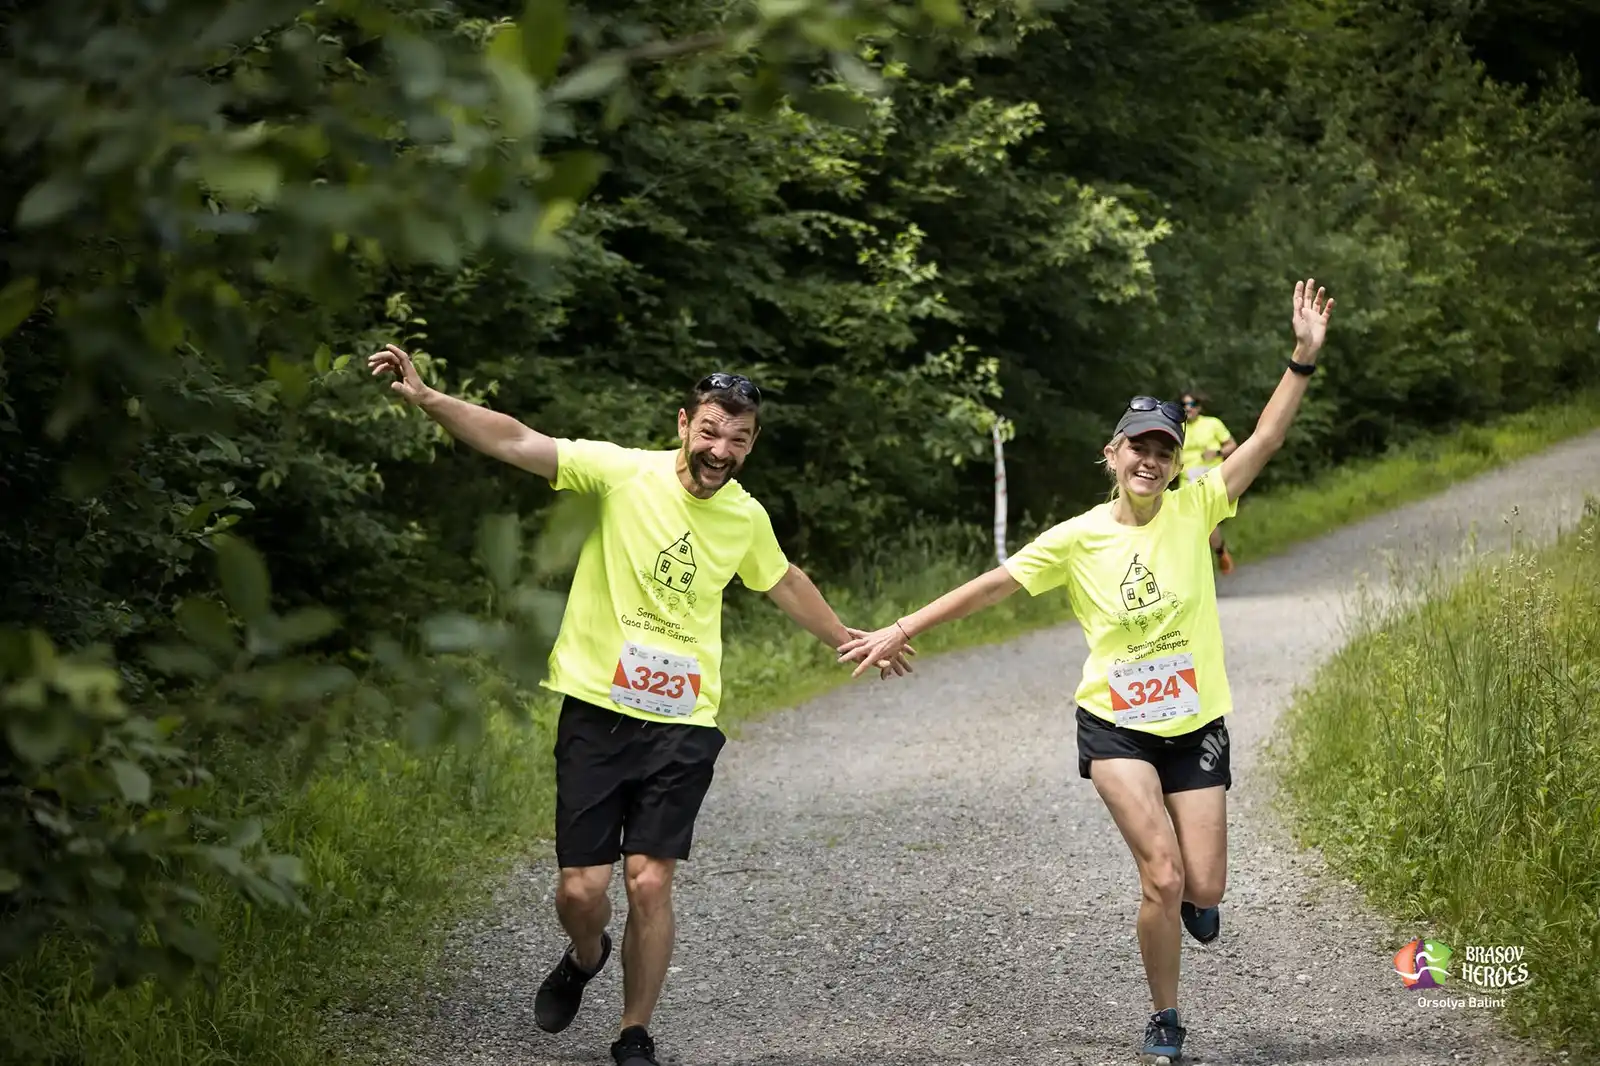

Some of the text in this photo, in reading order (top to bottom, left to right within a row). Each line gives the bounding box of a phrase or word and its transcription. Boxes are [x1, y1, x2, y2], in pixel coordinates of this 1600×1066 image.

[621, 614, 641, 628] Casa
[631, 666, 686, 699] 323
[1127, 675, 1181, 706] 324
